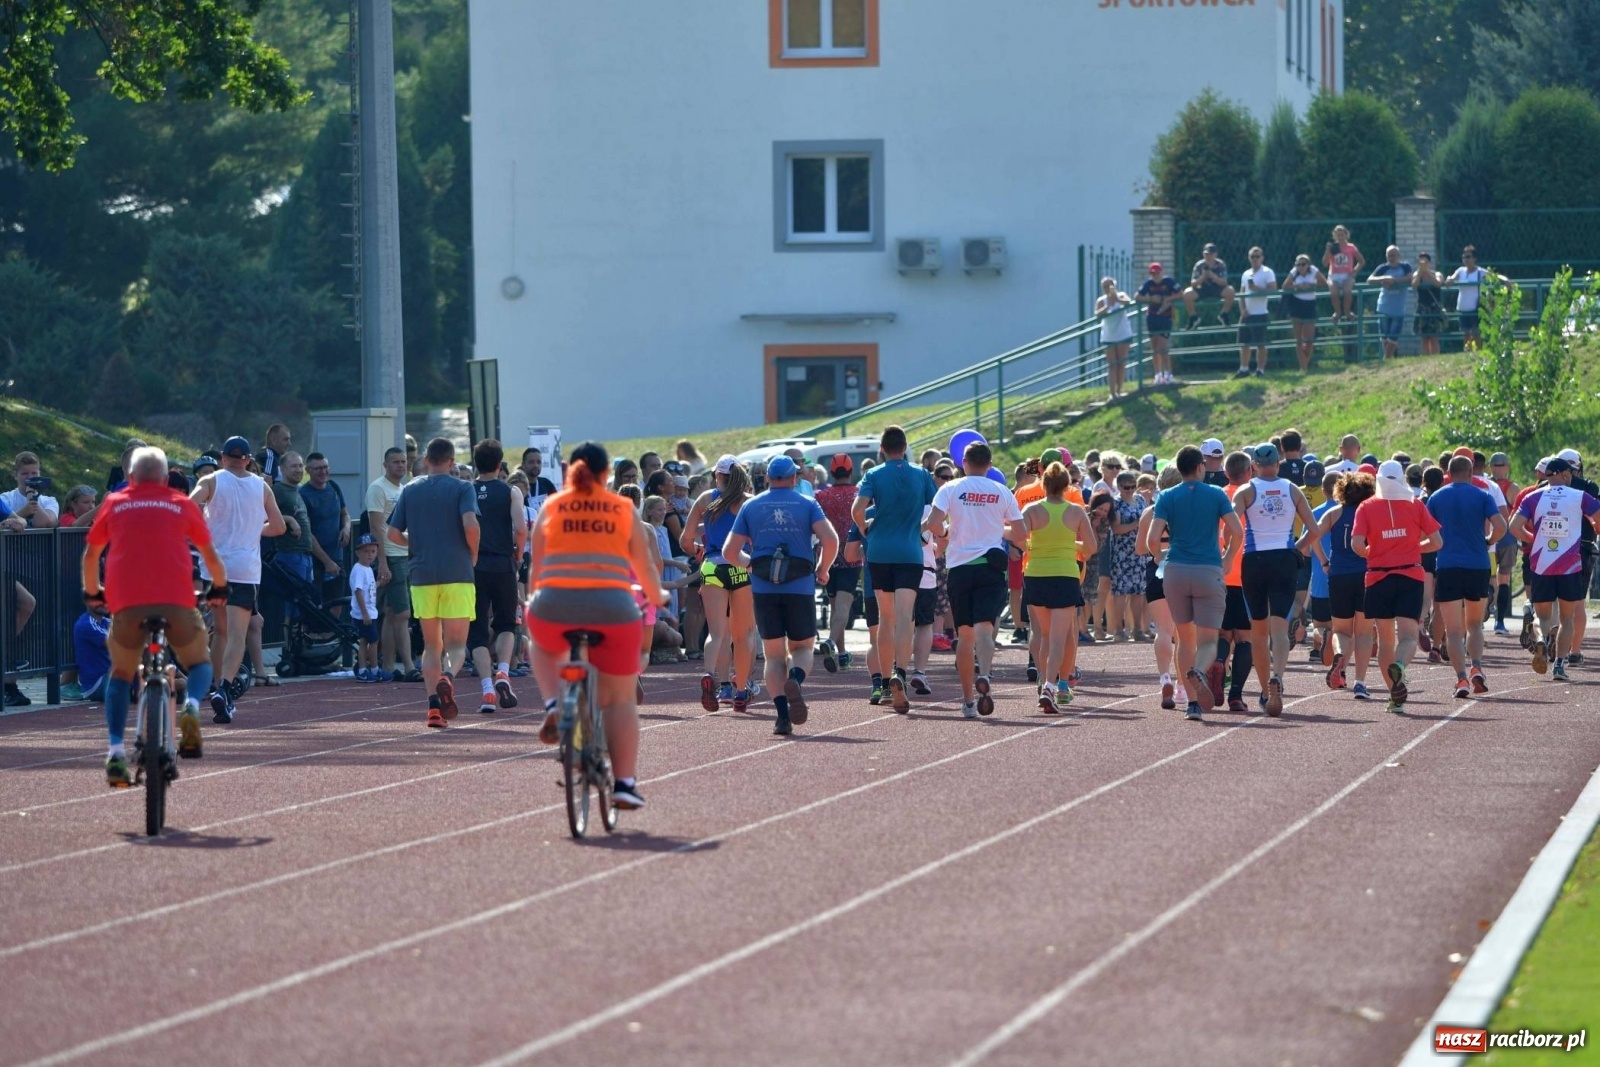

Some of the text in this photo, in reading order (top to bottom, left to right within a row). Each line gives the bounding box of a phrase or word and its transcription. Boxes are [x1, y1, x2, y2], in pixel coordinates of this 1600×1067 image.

[558, 500, 623, 515] KONIEC
[563, 519, 616, 534] BIEGU
[1548, 521, 1563, 529] 216
[1381, 528, 1407, 539] MAREK
[731, 573, 748, 586] TEAM
